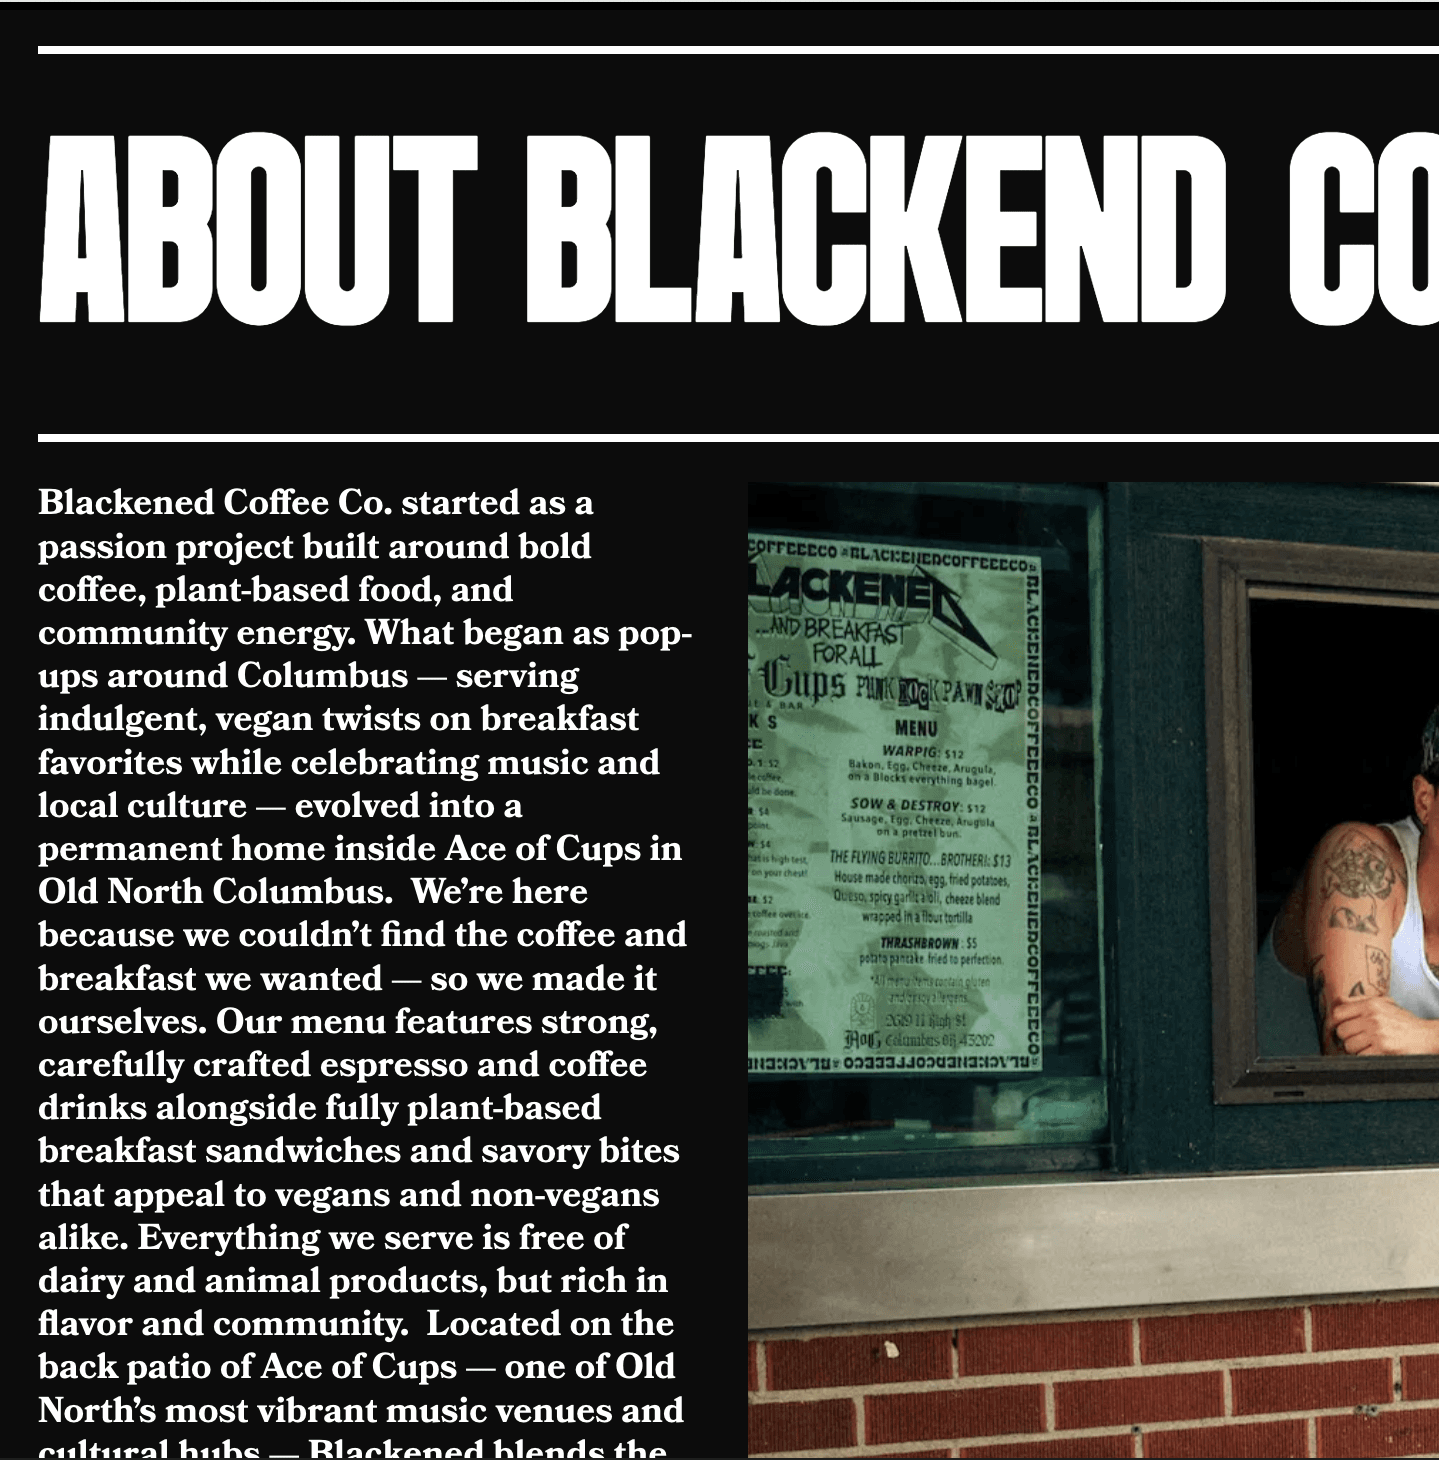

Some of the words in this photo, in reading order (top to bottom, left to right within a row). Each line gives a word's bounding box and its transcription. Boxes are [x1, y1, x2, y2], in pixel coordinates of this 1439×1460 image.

[804, 617, 911, 645] BREAKFAST
[813, 642, 848, 665] FOR
[849, 644, 883, 669] ALL
[758, 654, 847, 705] Cups
[856, 675, 895, 701] PUNK
[943, 679, 983, 706] PAWN
[895, 719, 938, 737] MENU
[944, 750, 964, 760] $12
[849, 759, 885, 771] Bakon,
[873, 772, 907, 783] Blocks
[909, 775, 963, 787] everything
[851, 797, 884, 810] SOW
[886, 799, 896, 810] &
[900, 799, 964, 813] DESTROY:
[967, 804, 986, 814] $12
[902, 828, 937, 839] pretzel
[830, 849, 848, 863] THE
[851, 850, 886, 865] FLYING
[993, 854, 1011, 868] $13
[834, 870, 863, 883] House
[865, 871, 891, 884] made
[976, 893, 1000, 906] blend
[862, 911, 901, 925] wrapped
[966, 937, 978, 949] $5
